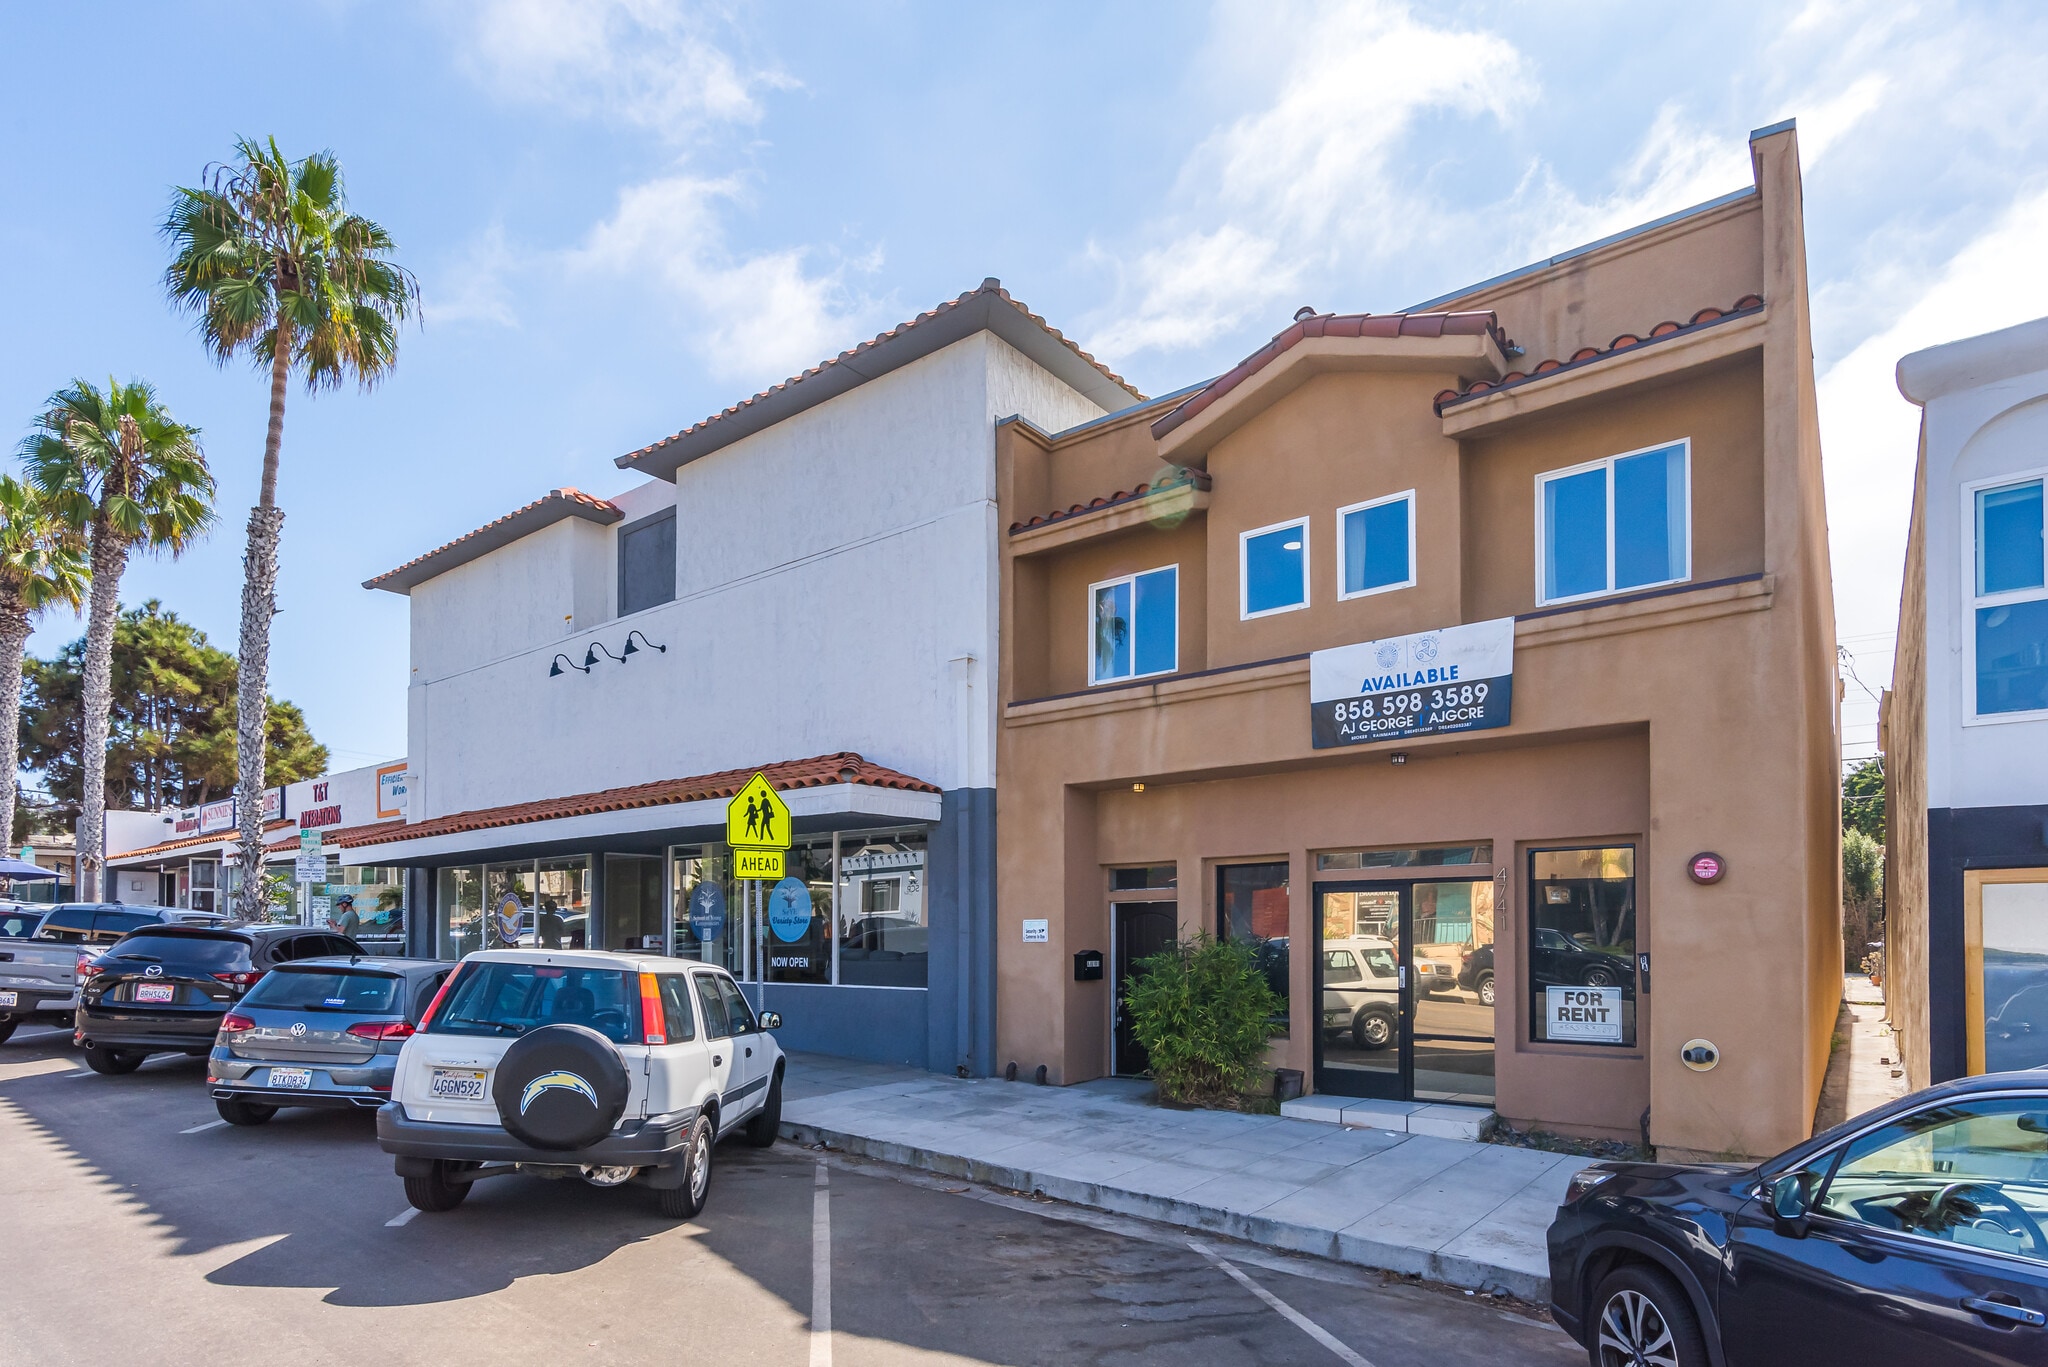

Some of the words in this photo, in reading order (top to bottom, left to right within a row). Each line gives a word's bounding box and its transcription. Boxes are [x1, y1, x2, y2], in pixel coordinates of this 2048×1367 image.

[1360, 664, 1459, 693] AVAILABLE
[1340, 720, 1356, 735] AJ
[1359, 715, 1414, 733] GEORGE
[1429, 706, 1484, 724] AJGCRE
[1372, 730, 1400, 738] RAINMAKER
[313, 782, 329, 803] T&T
[392, 786, 407, 797] WOR
[300, 805, 342, 829] ALTERATIONS
[741, 857, 779, 871] AHEAD
[1496, 867, 1507, 931] 4741
[793, 916, 809, 925] Store
[771, 957, 788, 968] NOW
[789, 956, 809, 968] OPEN
[1564, 990, 1603, 1007] FOR
[1558, 1006, 1610, 1023] RENT
[433, 1078, 482, 1095] 4GGN592
